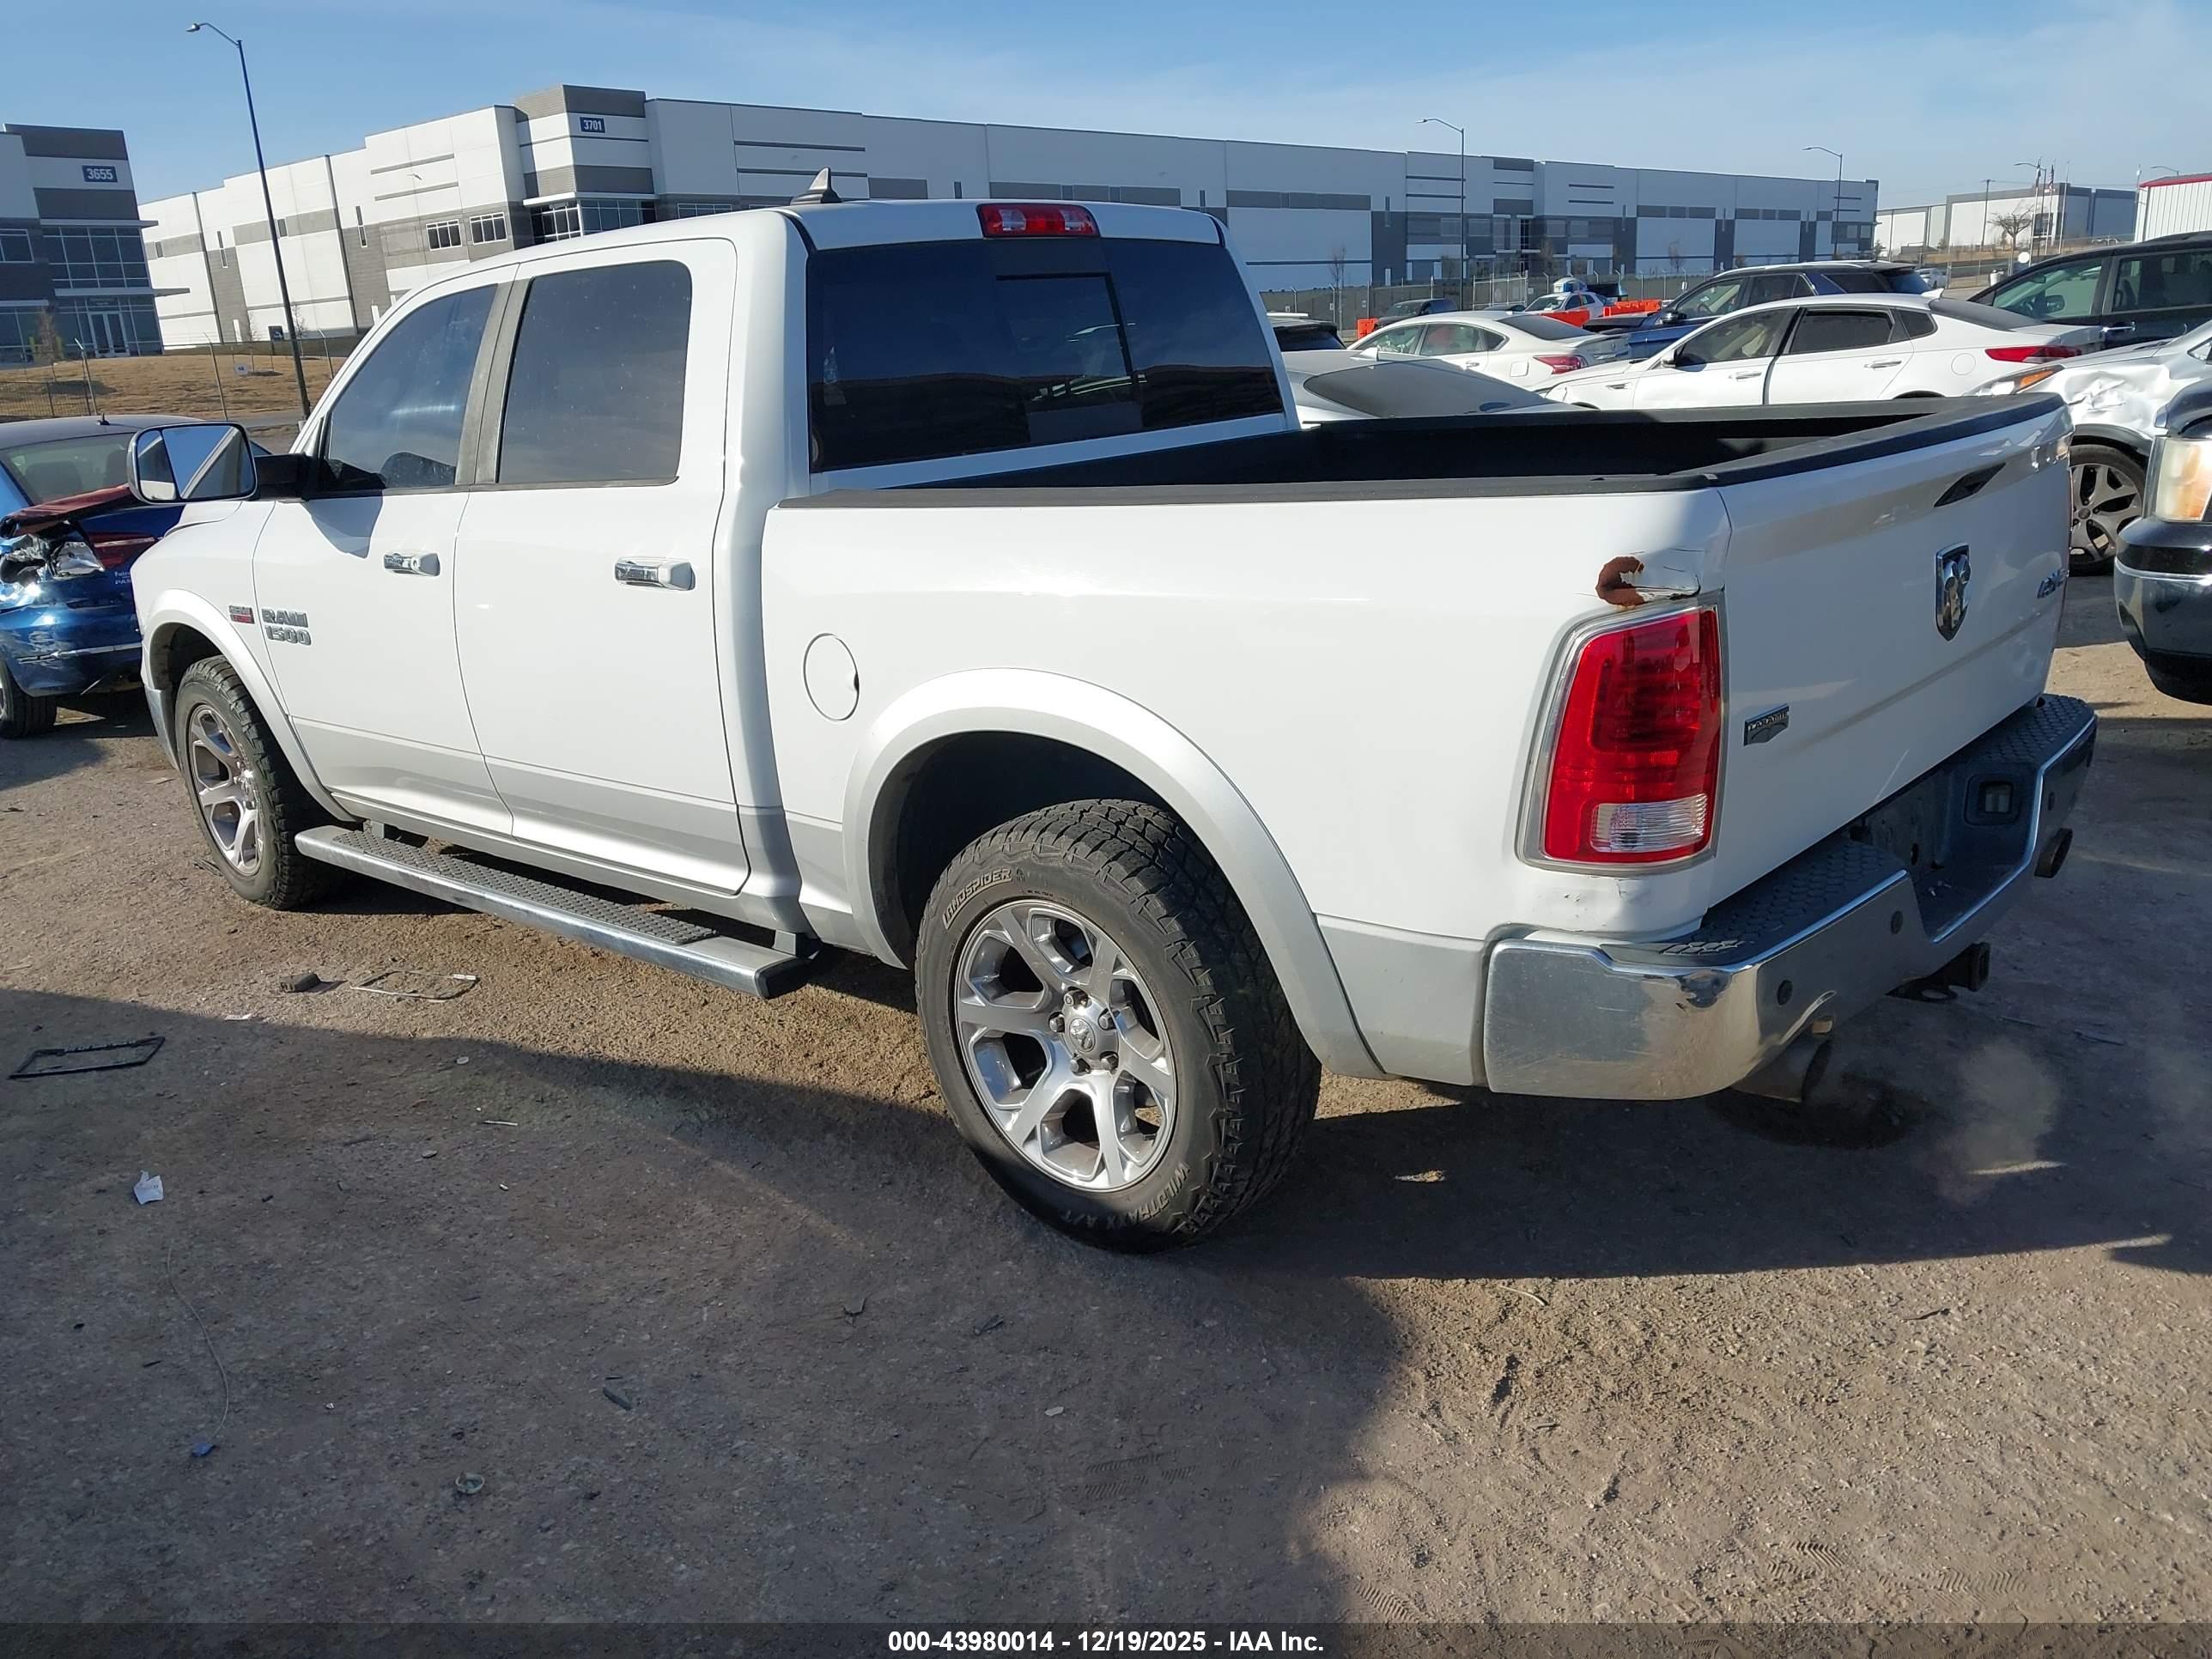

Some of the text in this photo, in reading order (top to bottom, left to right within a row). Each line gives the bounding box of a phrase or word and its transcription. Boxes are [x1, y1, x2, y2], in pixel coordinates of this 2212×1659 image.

[583, 119, 602, 131] 3701
[87, 168, 113, 179] 3655
[261, 608, 309, 628] RAM
[264, 625, 312, 646] 1500
[943, 868, 1012, 930] LANDSPIDER
